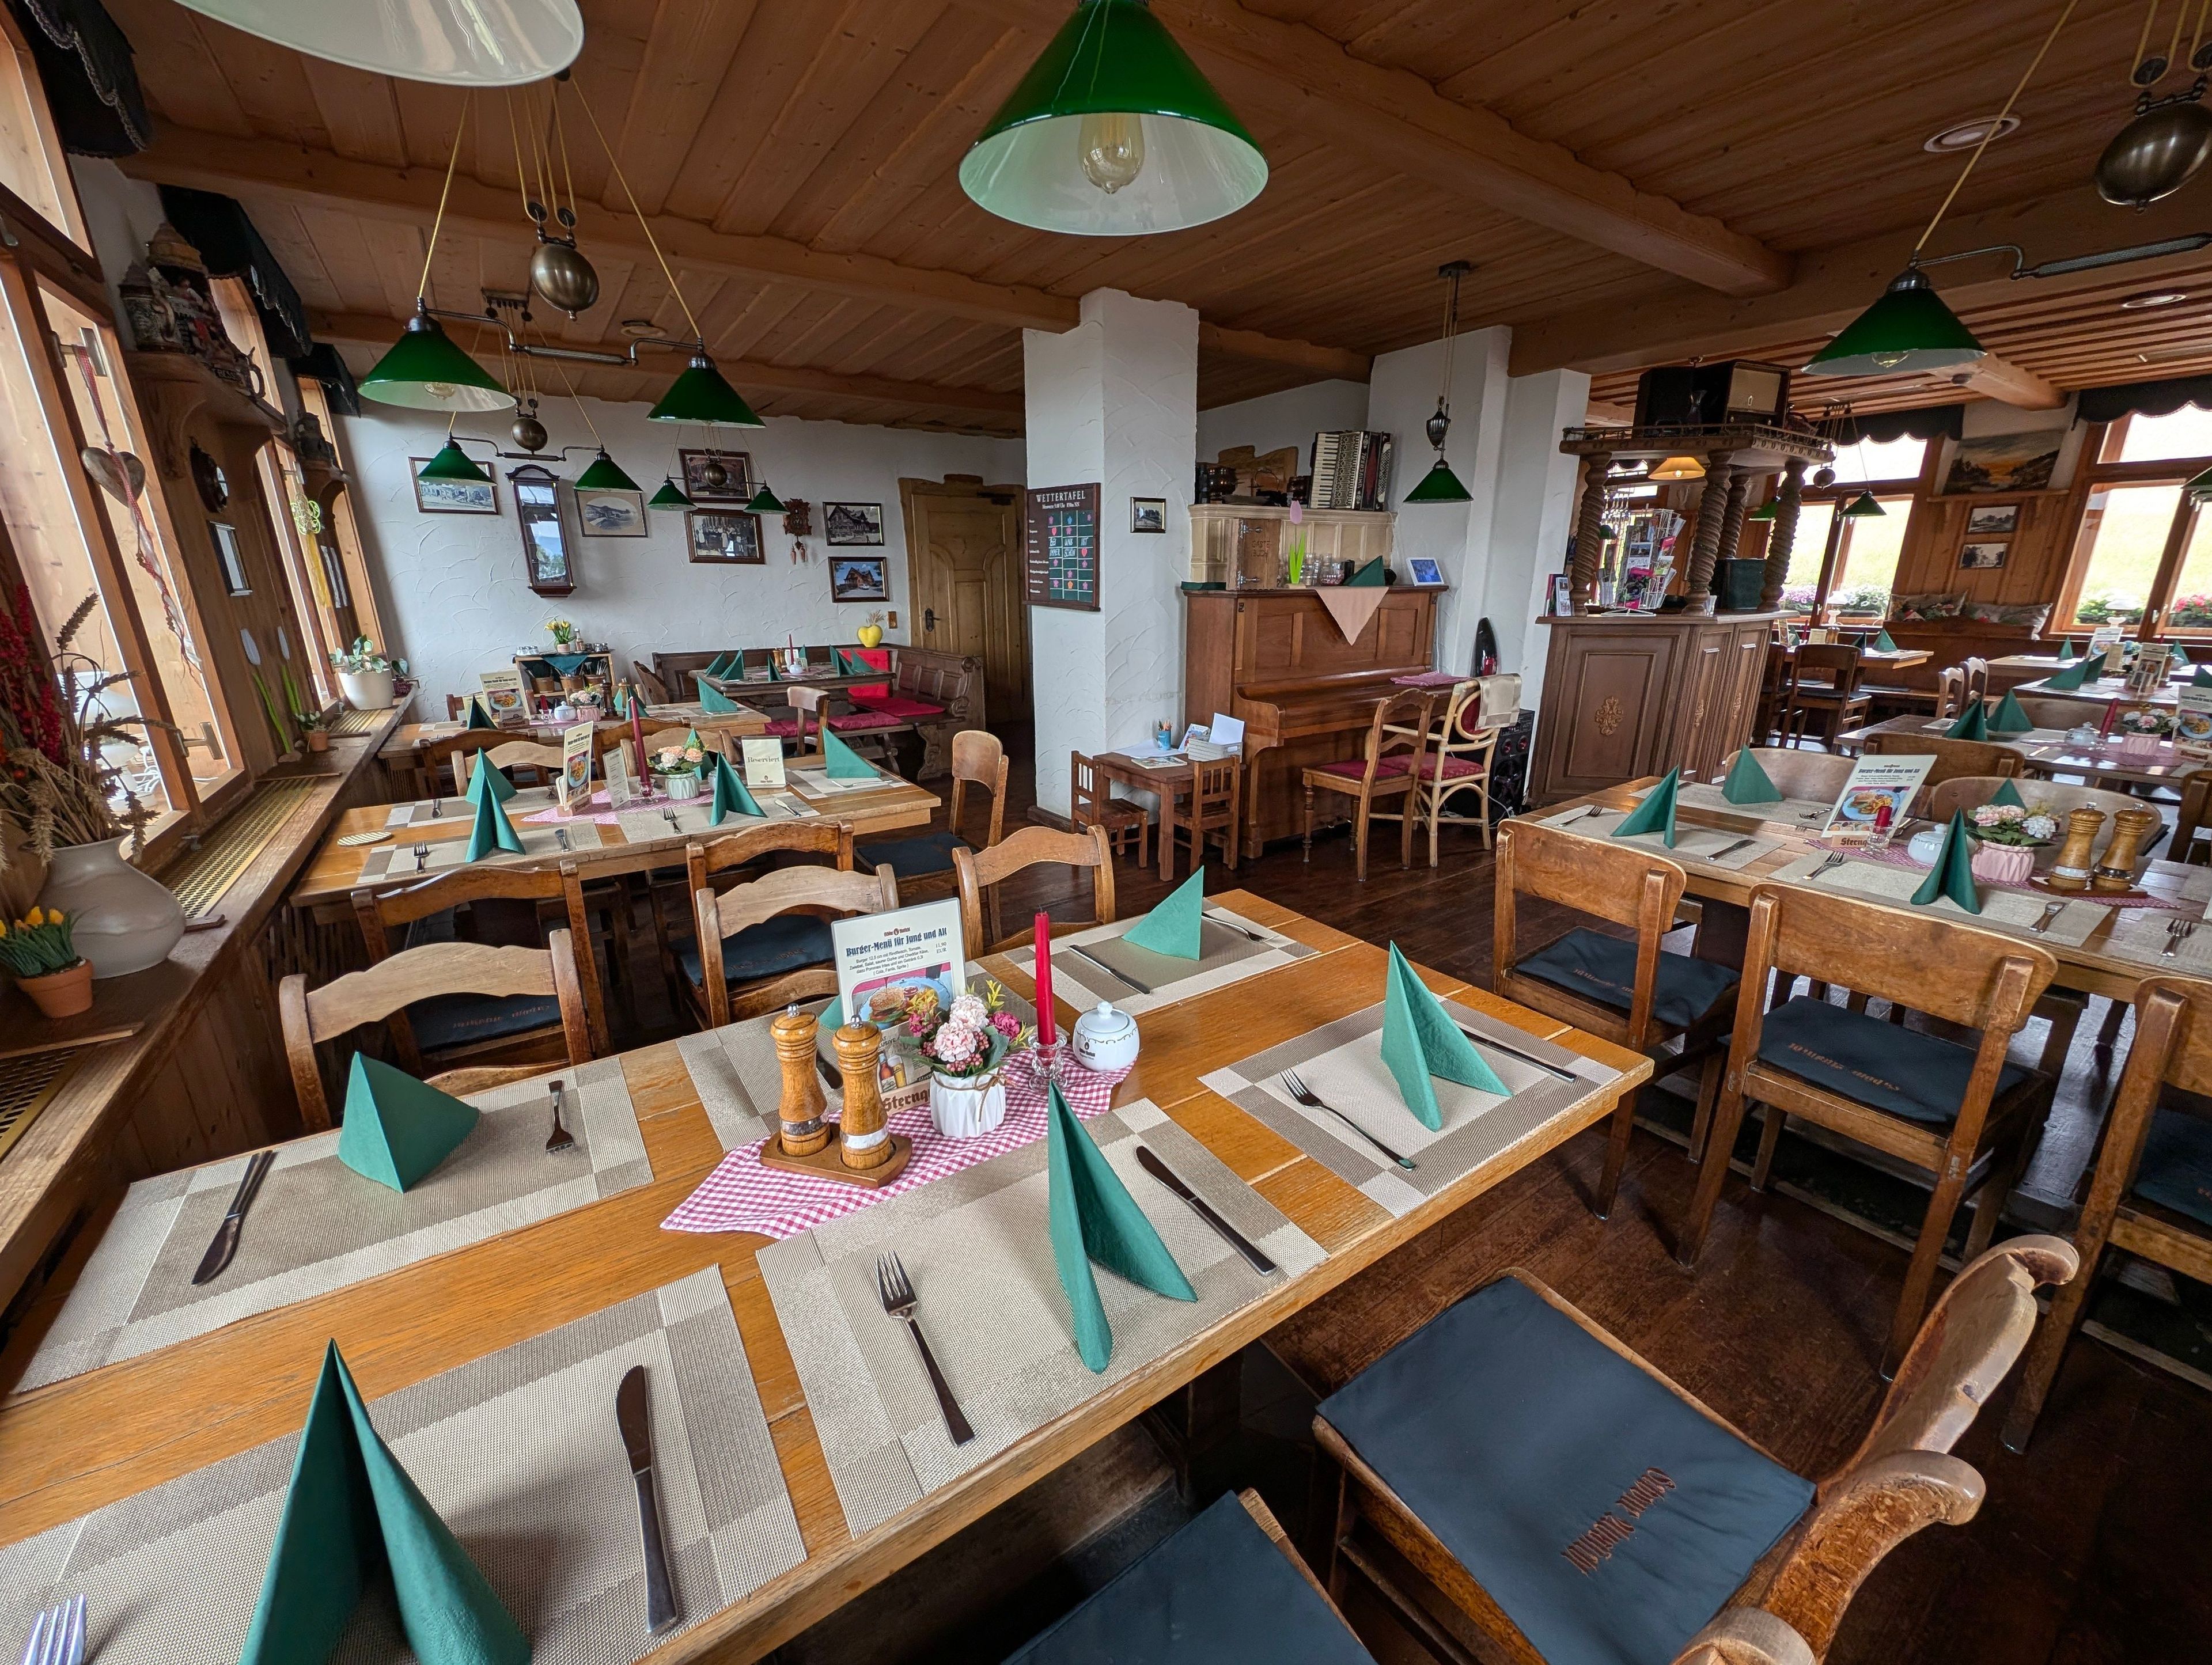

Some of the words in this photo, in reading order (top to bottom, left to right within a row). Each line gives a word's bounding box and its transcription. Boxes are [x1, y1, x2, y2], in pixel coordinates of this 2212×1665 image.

[1357, 452, 1367, 488] UNIVERSAL
[1036, 491, 1086, 502] WETTERTAFEL
[846, 939, 893, 957] Burger-Menü
[894, 935, 904, 947] für
[906, 932, 922, 945] Jung
[923, 929, 937, 940] und
[938, 927, 948, 937] Alt
[882, 1088, 930, 1112] Sternq
